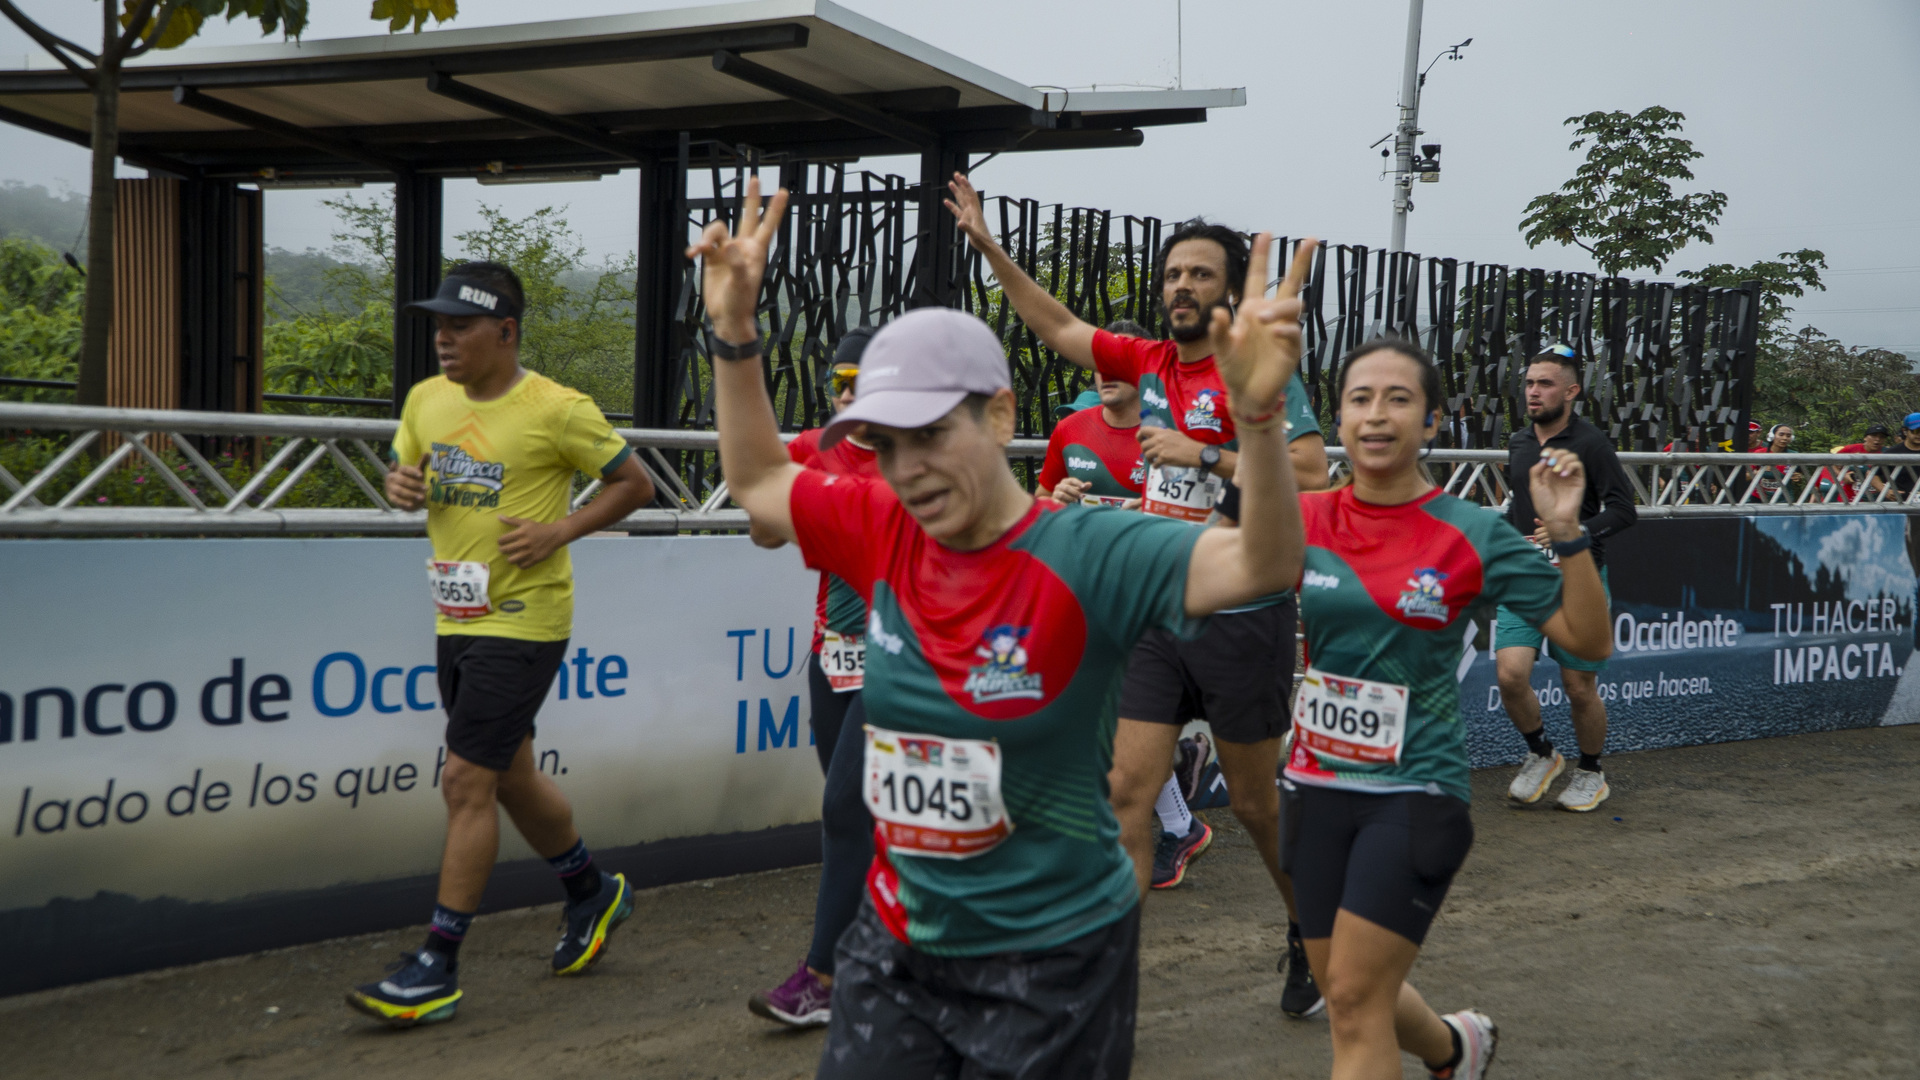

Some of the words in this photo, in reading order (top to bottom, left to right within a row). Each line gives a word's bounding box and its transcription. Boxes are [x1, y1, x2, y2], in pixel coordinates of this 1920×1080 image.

[458, 284, 499, 311] RUN
[431, 450, 504, 481] Muñeca
[1158, 479, 1196, 502] 457
[1614, 611, 1738, 652] Occidente
[1770, 603, 1803, 638] TU
[1812, 599, 1903, 636] HACER,
[727, 626, 795, 680] TU
[1773, 642, 1903, 685] IMPACTA.
[0, 681, 178, 745] nco
[199, 658, 291, 727] de
[1621, 679, 1654, 706] que
[1657, 671, 1713, 697] hacen.
[1308, 698, 1380, 738] 1069
[15, 777, 149, 838] lado
[166, 768, 231, 816] de
[249, 762, 319, 809] los
[334, 762, 418, 809] que
[883, 771, 972, 821] 1045
